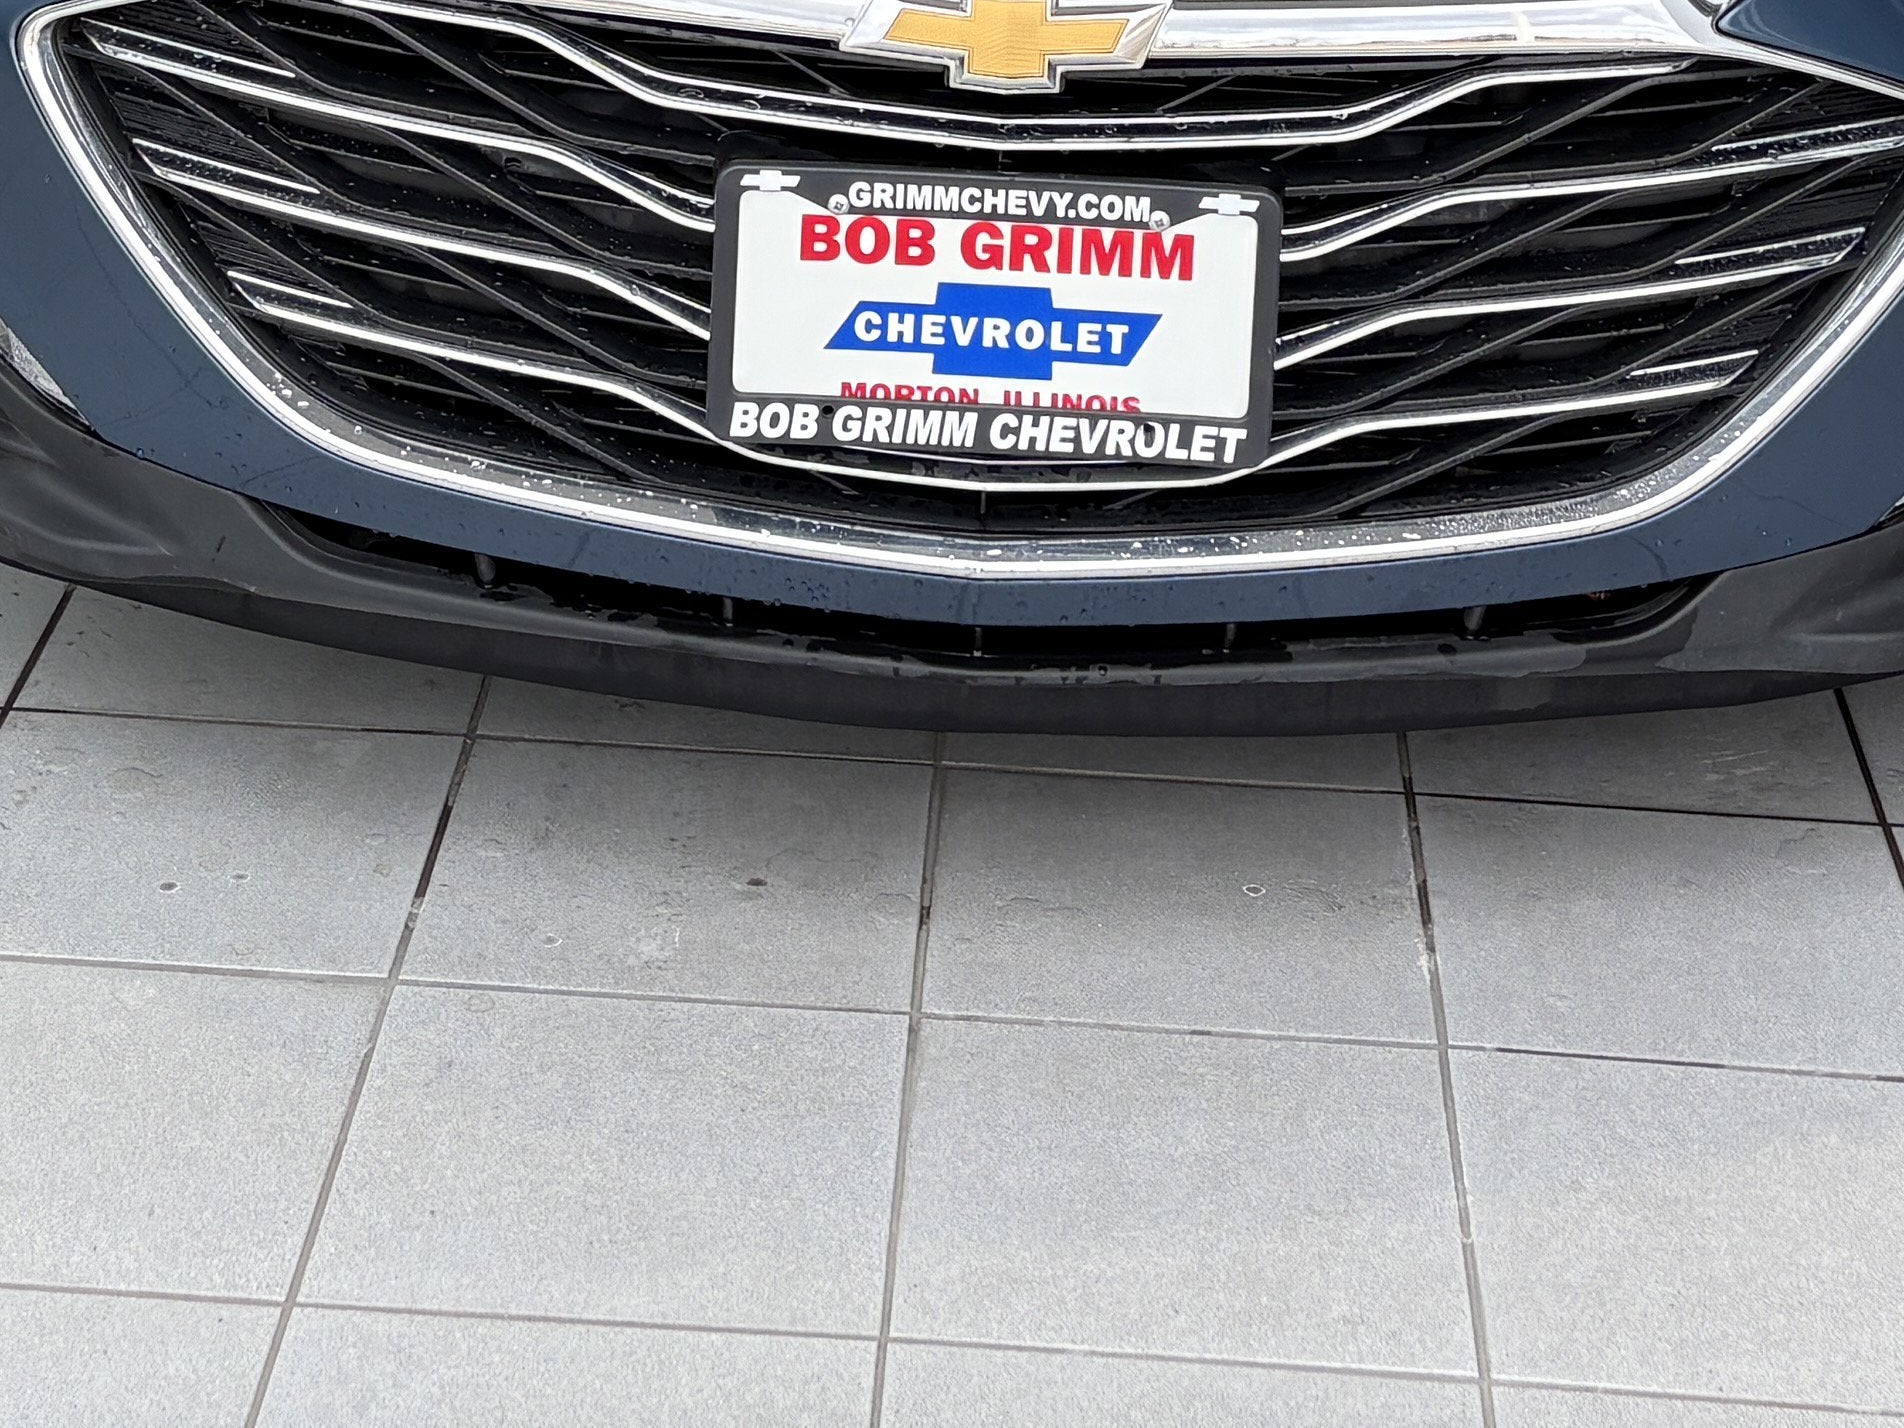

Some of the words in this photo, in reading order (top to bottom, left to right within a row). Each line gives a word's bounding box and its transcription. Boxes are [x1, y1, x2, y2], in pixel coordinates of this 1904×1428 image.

[848, 181, 1151, 222] GRIMMCHEVY.COM
[800, 214, 935, 266] BOB
[960, 220, 1195, 281] GRIMM
[854, 310, 1130, 355] CHEVROLET
[729, 401, 820, 440] BOB
[832, 405, 978, 448] GRIMM
[989, 412, 1247, 464] CHEVROLET
